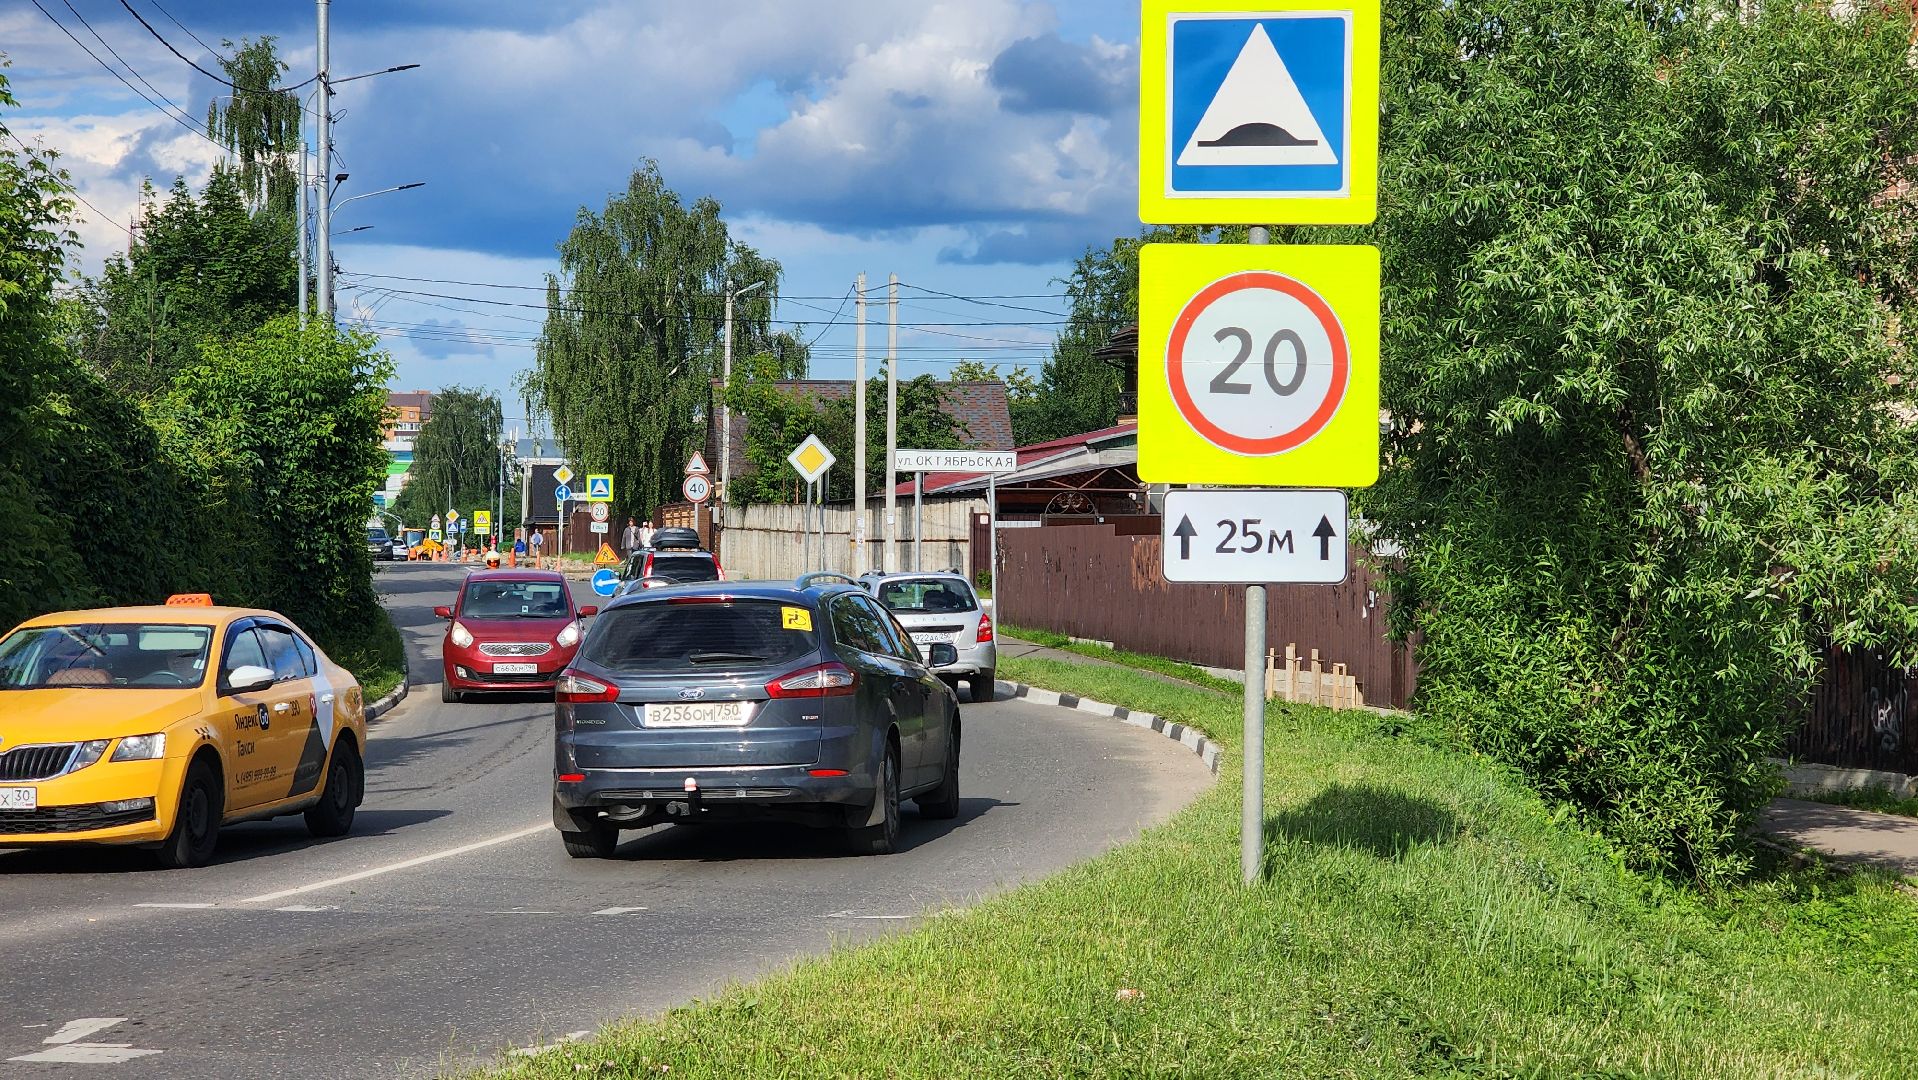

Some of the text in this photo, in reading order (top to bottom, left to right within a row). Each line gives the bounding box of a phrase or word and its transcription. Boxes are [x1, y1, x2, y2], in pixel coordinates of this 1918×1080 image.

[1209, 326, 1307, 397] 20
[916, 455, 1013, 468] ОКТЯБРЬСКАЯ
[690, 483, 705, 494] 40
[595, 507, 605, 516] 20
[683, 690, 699, 698] Ford
[234, 708, 269, 731] Яндекс Go
[652, 704, 739, 722] В256ОМ 750
[237, 740, 255, 757] Такси
[15, 790, 30, 801] 30
